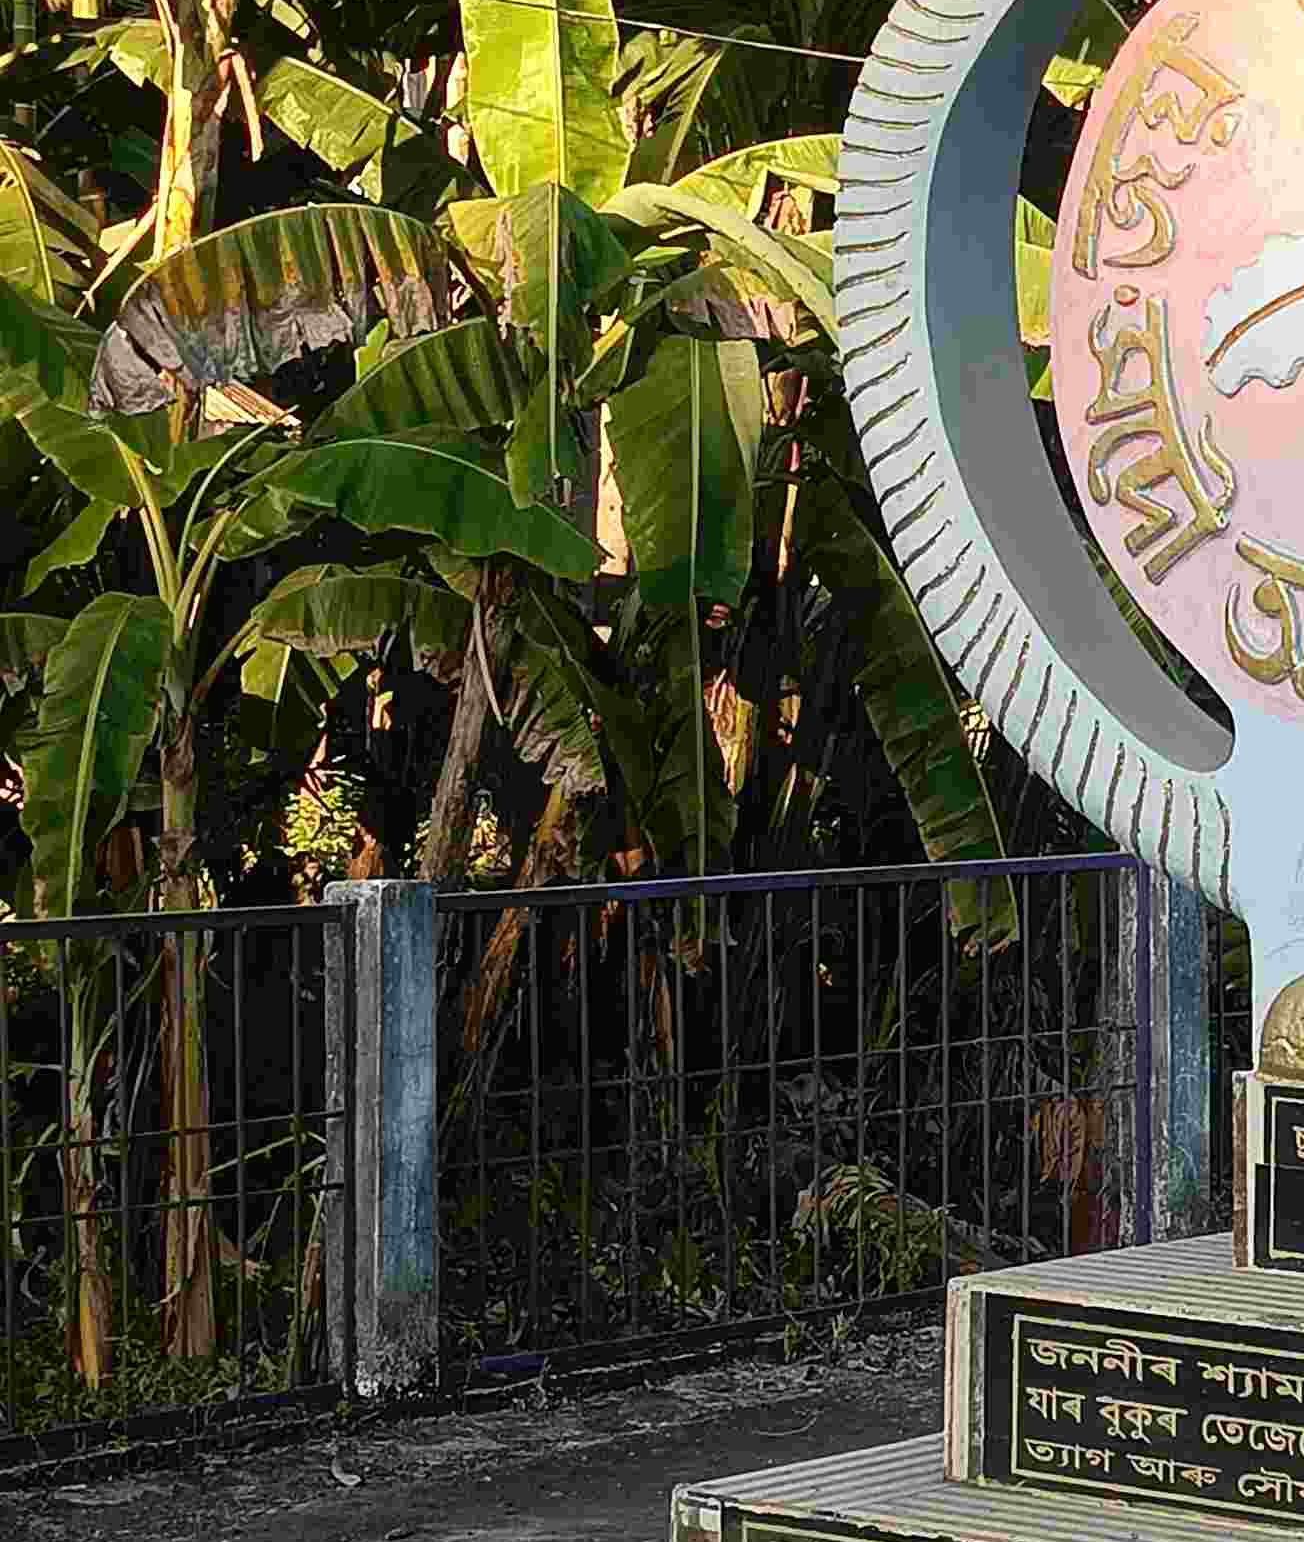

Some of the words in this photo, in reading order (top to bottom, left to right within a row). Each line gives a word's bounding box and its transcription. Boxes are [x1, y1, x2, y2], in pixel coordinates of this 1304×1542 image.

[1026, 1337, 1182, 1387] জননীৰ
[1025, 1385, 1086, 1423] যাৰ
[1096, 1395, 1189, 1444] বুকুৰ
[1024, 1437, 1116, 1473] ত্যাগ
[1126, 1453, 1222, 1487] আৰু
